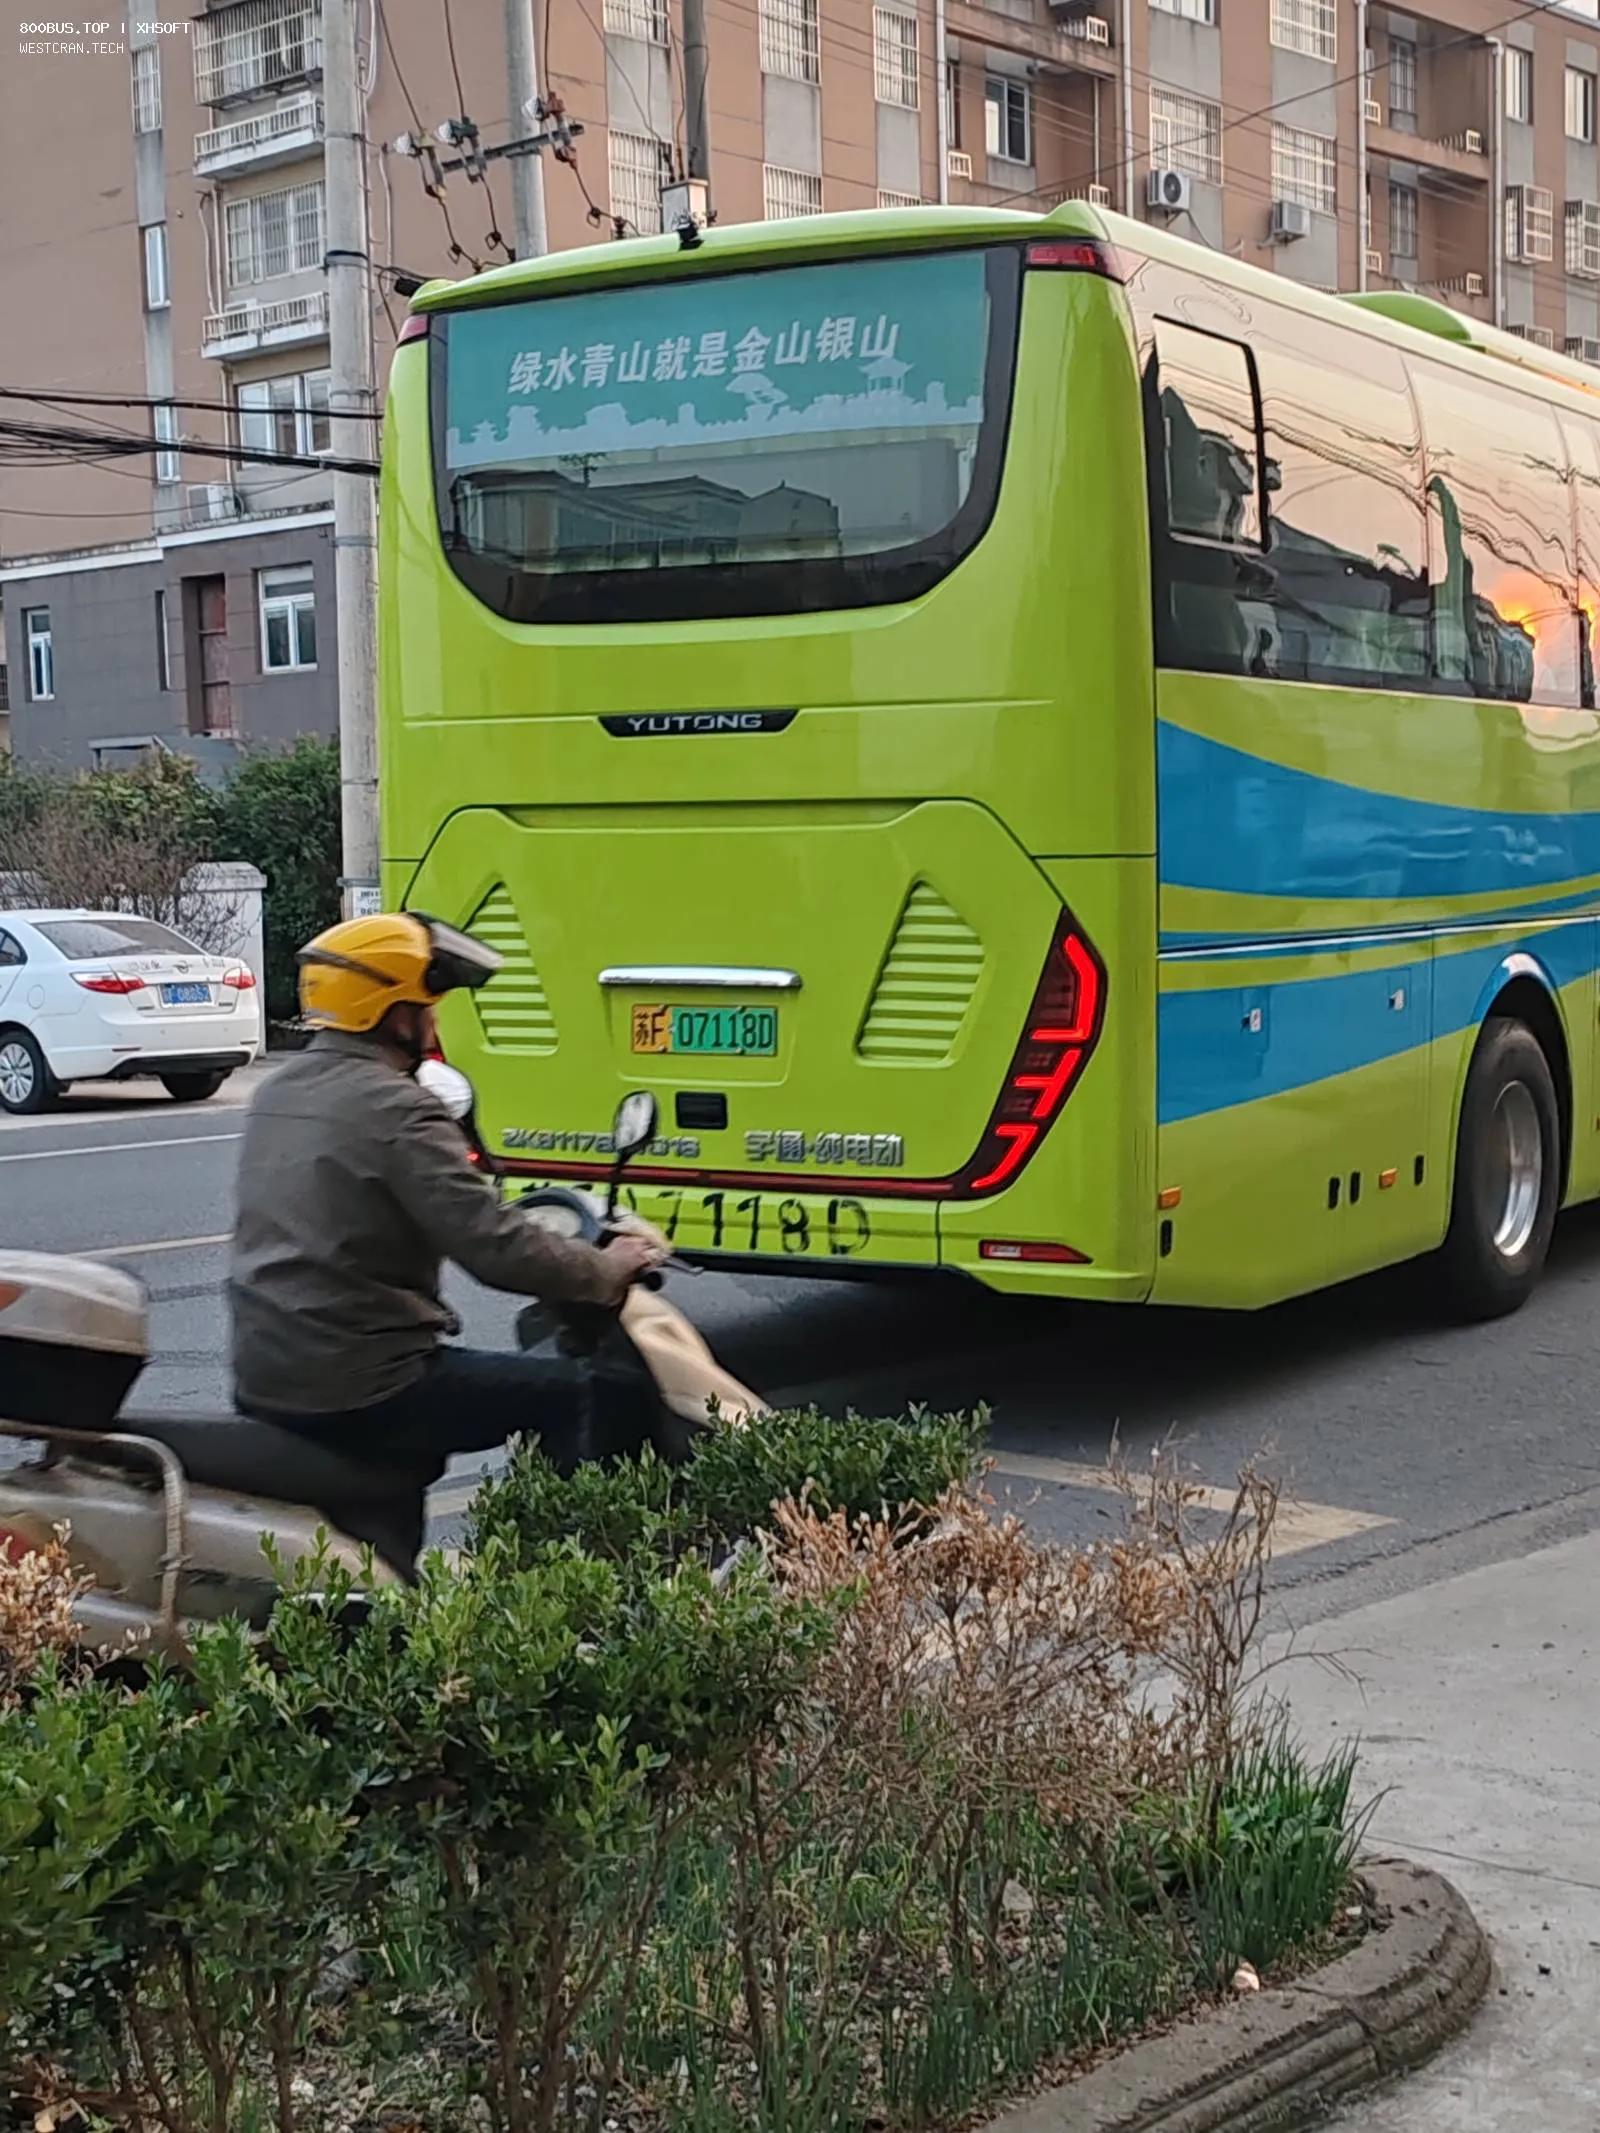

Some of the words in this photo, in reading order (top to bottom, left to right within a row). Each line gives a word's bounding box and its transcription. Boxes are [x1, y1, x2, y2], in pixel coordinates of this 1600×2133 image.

[507, 314, 900, 396] 绿水青山就是金山银山
[627, 713, 763, 732] YUTONG
[634, 1011, 774, 1050] 苏F07118D
